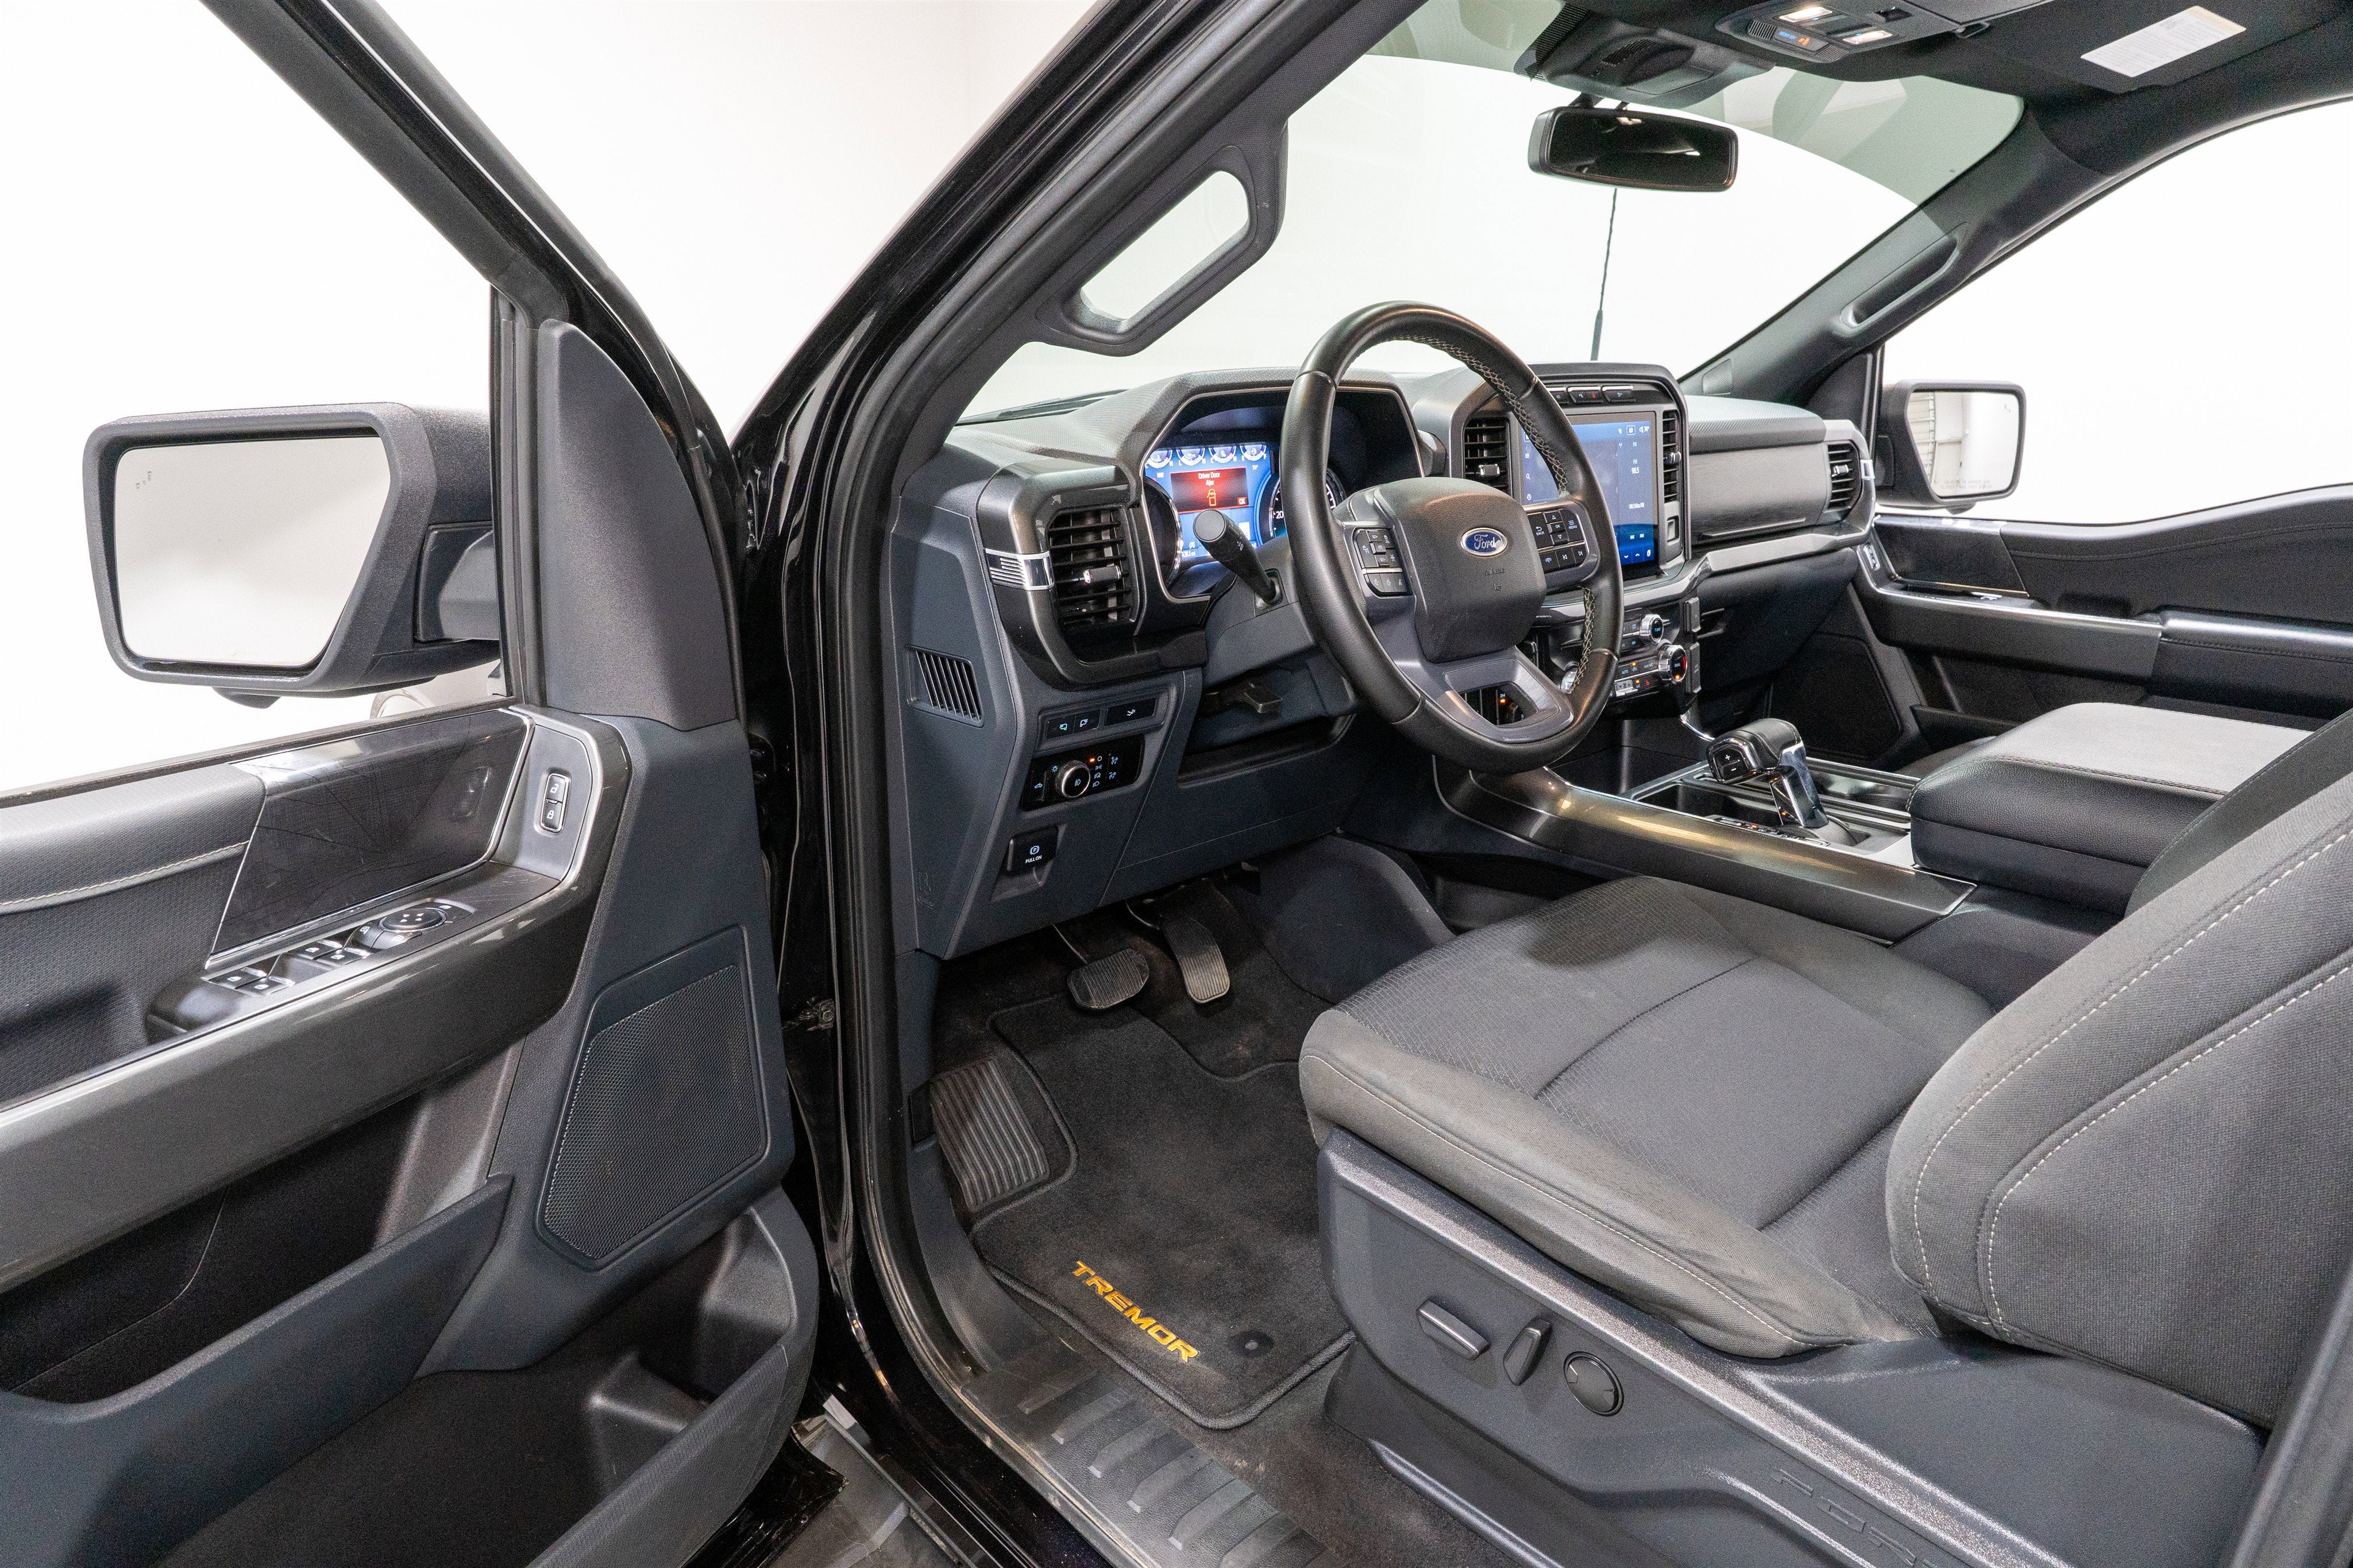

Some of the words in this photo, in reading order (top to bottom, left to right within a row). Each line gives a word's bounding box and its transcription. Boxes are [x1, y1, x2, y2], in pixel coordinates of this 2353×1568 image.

[1276, 511, 1284, 519] 20
[1474, 534, 1497, 550] Ford
[1072, 1260, 1198, 1363] TREMOR
